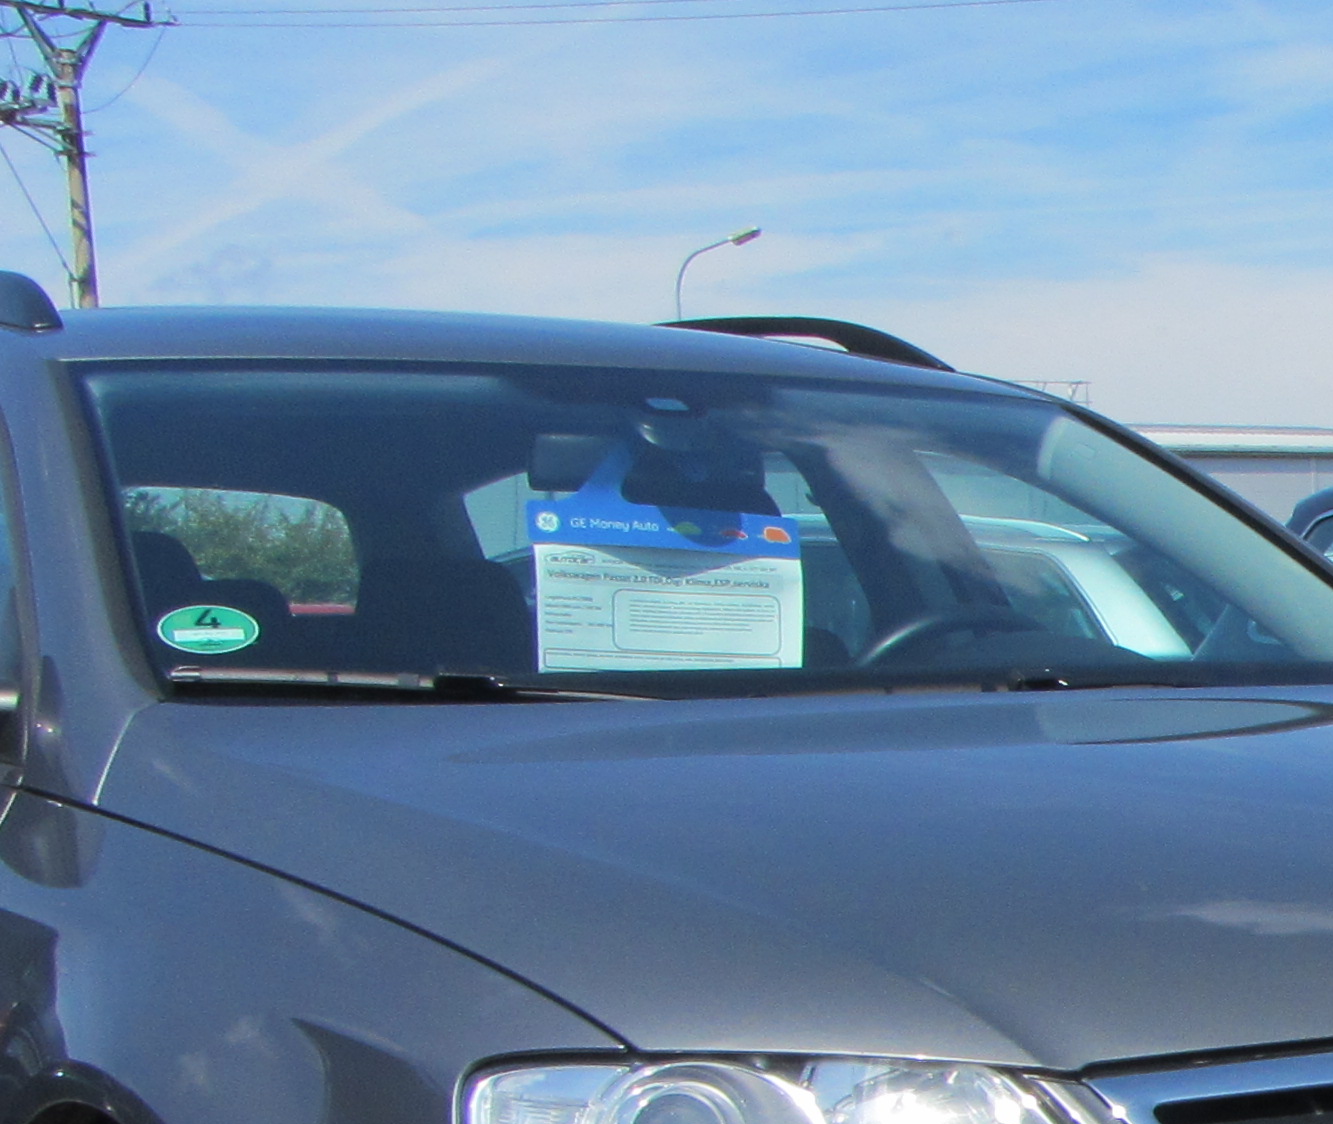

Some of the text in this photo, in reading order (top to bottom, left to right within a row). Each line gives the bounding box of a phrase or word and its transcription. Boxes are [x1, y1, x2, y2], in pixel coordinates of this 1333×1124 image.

[570, 517, 586, 529] GE
[590, 518, 630, 532] Money
[632, 520, 660, 532] Auto
[194, 608, 221, 629] 4
